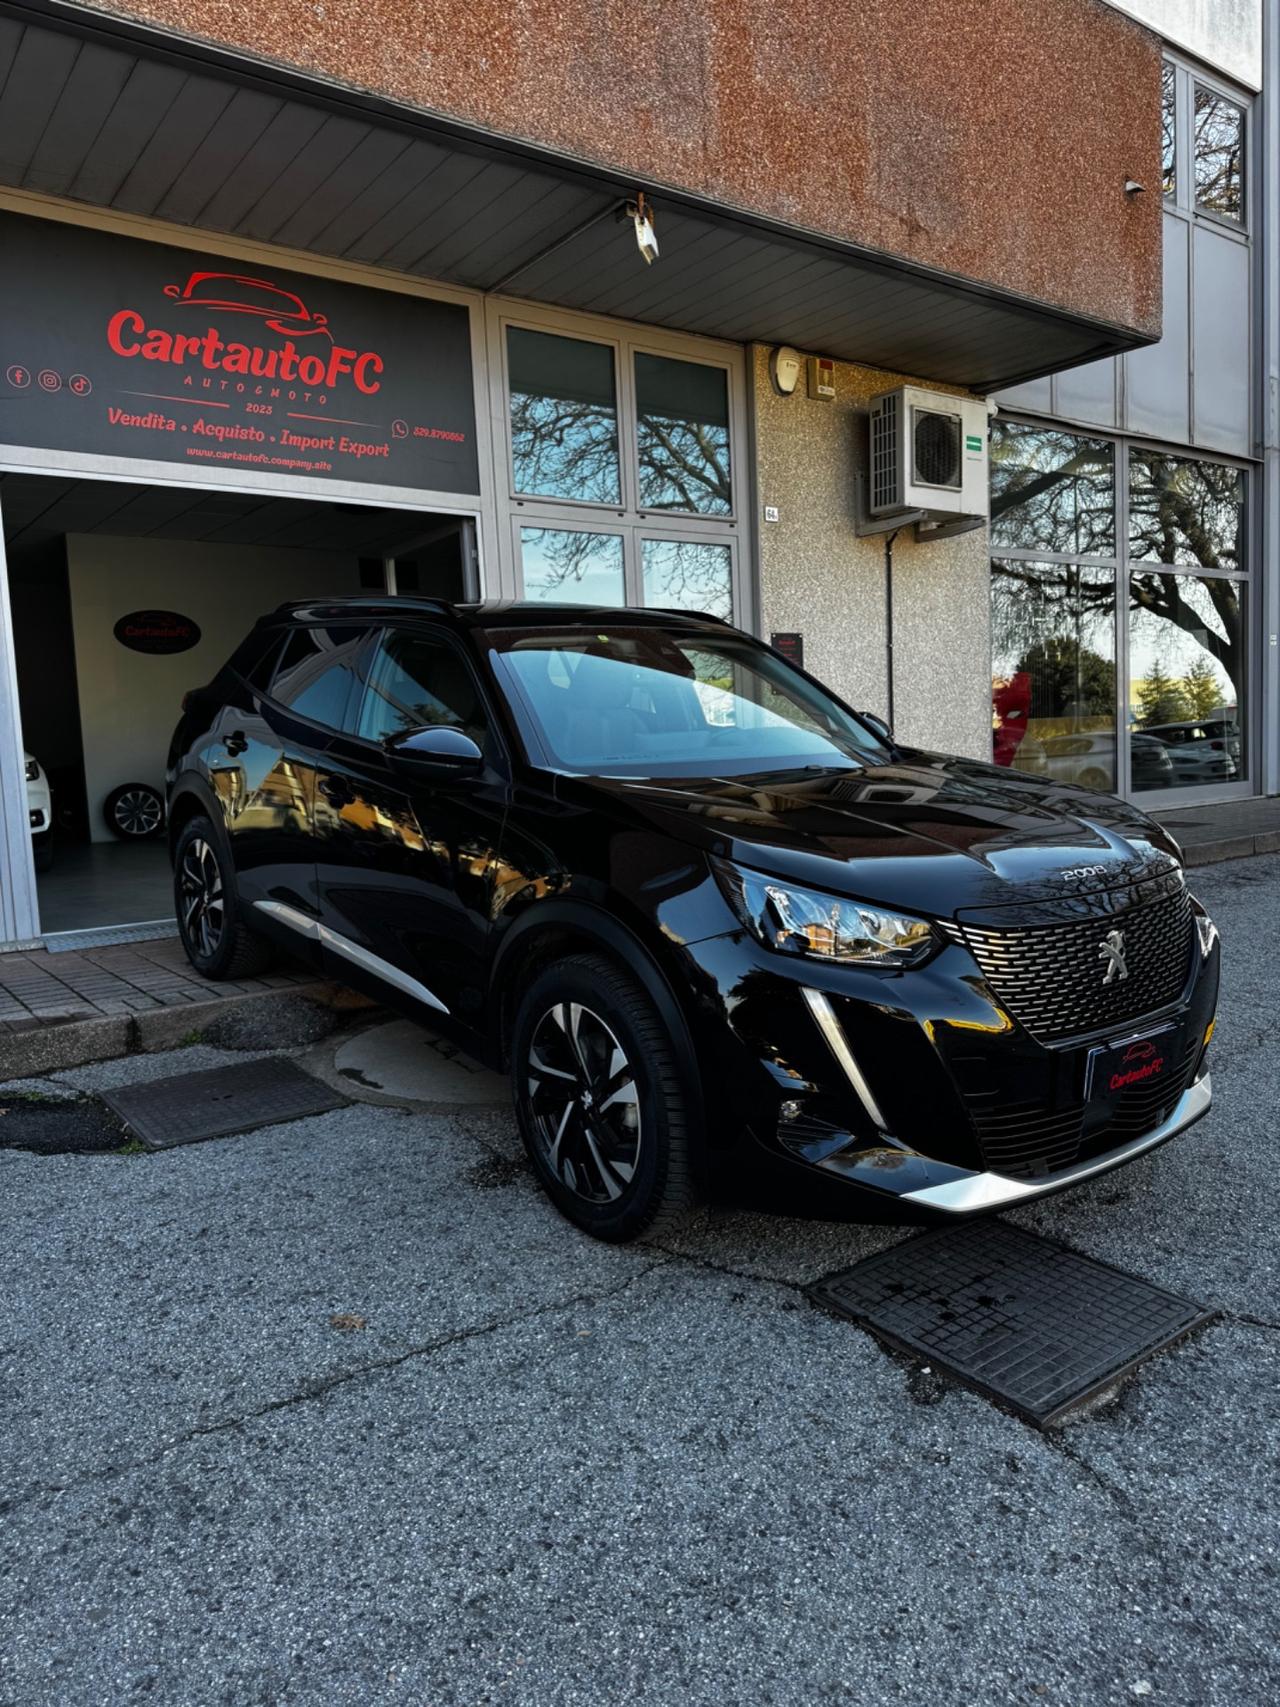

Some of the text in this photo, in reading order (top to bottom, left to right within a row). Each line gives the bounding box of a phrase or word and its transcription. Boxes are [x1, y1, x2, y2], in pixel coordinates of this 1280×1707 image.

[107, 309, 384, 394] CartautoFC
[246, 402, 273, 415] 2023
[108, 407, 390, 458] Vendita Acquisto Import Export
[1060, 865, 1107, 881] 2008
[1109, 1057, 1164, 1089] CartautoFC
